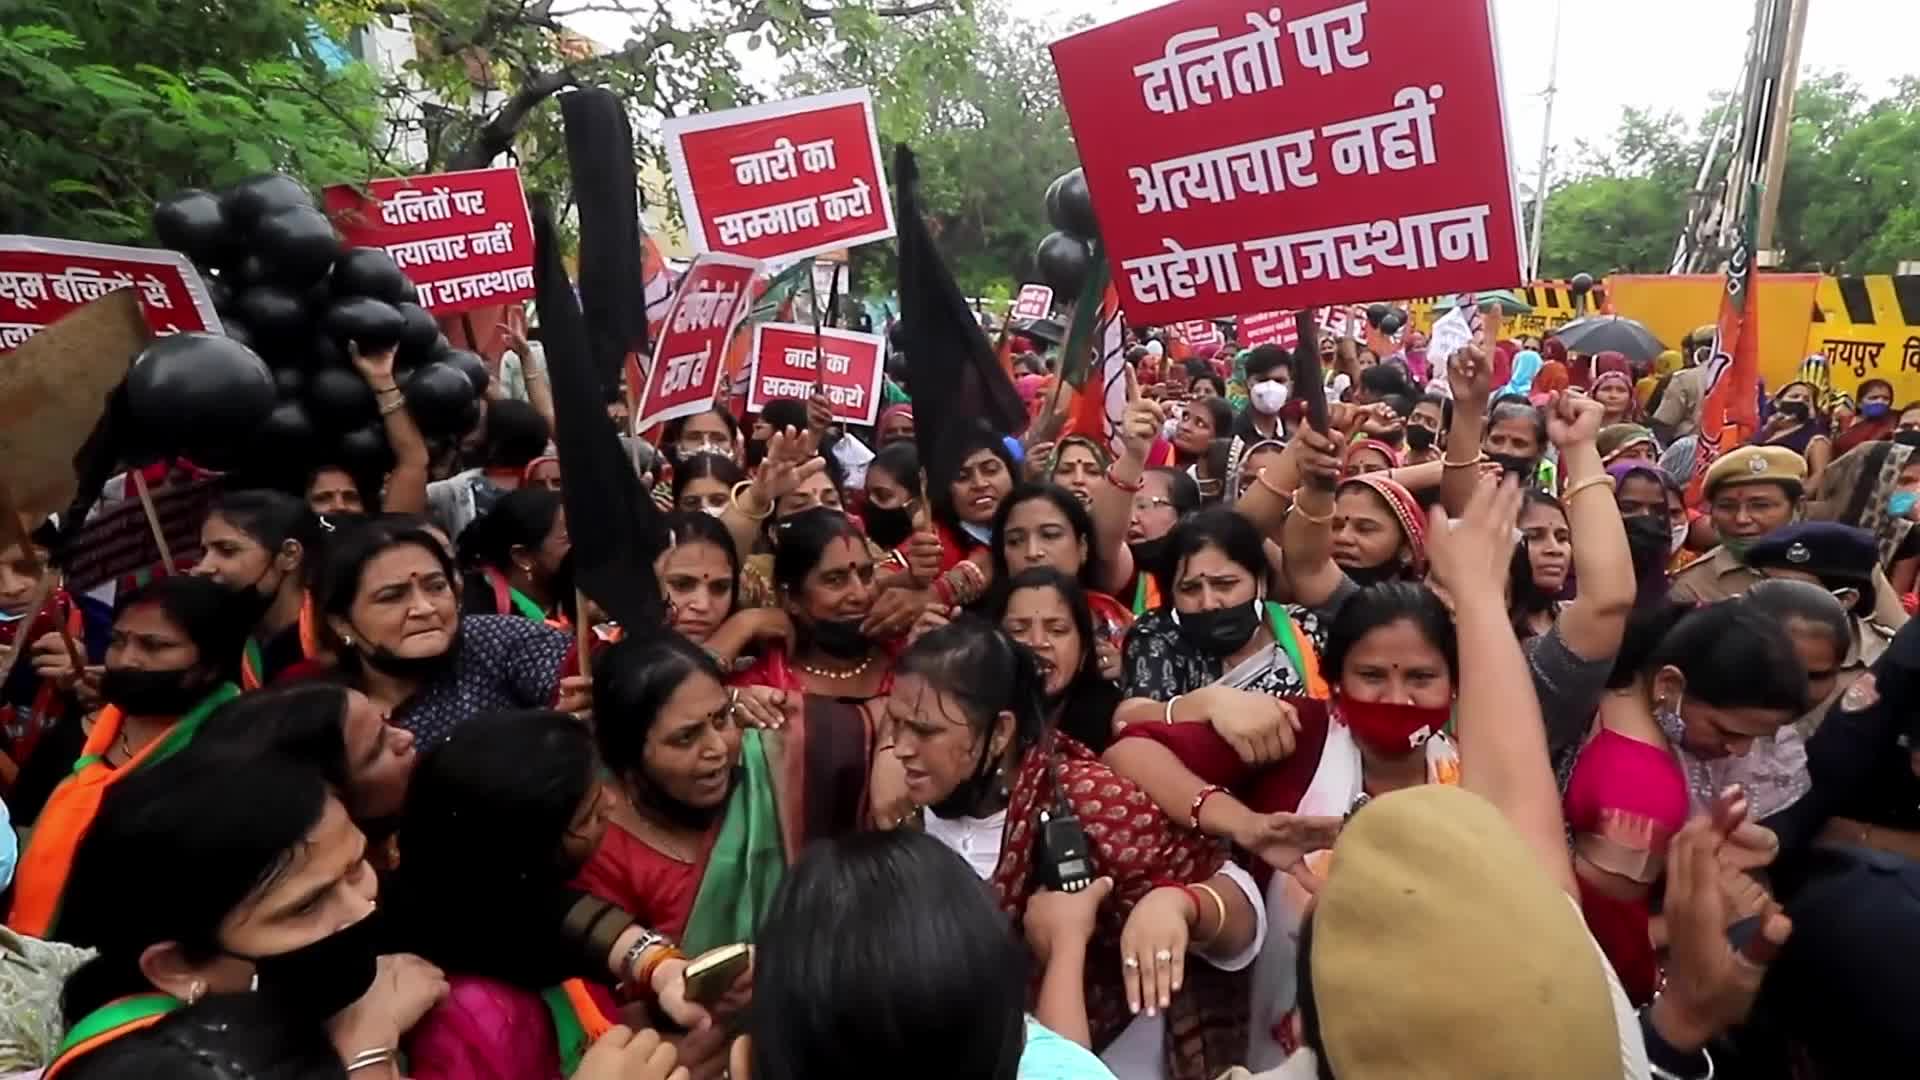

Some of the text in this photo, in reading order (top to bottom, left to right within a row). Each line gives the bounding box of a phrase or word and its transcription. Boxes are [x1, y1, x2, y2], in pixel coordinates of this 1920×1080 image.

[1132, 1, 1370, 115] दलितों पर
[729, 137, 836, 186] नारी का
[1128, 84, 1444, 215] अत्याचार नहीं
[381, 187, 486, 226] दलितों पर
[712, 176, 873, 246] सम्मान करो
[385, 222, 514, 268] त्याचार नहीं
[1121, 204, 1490, 303] सहेगा राजस्थान
[136, 273, 174, 309] से
[434, 266, 535, 303] राजस्थान
[826, 353, 851, 375] का
[1823, 339, 1886, 377] जयपुर
[830, 383, 865, 408] करो
